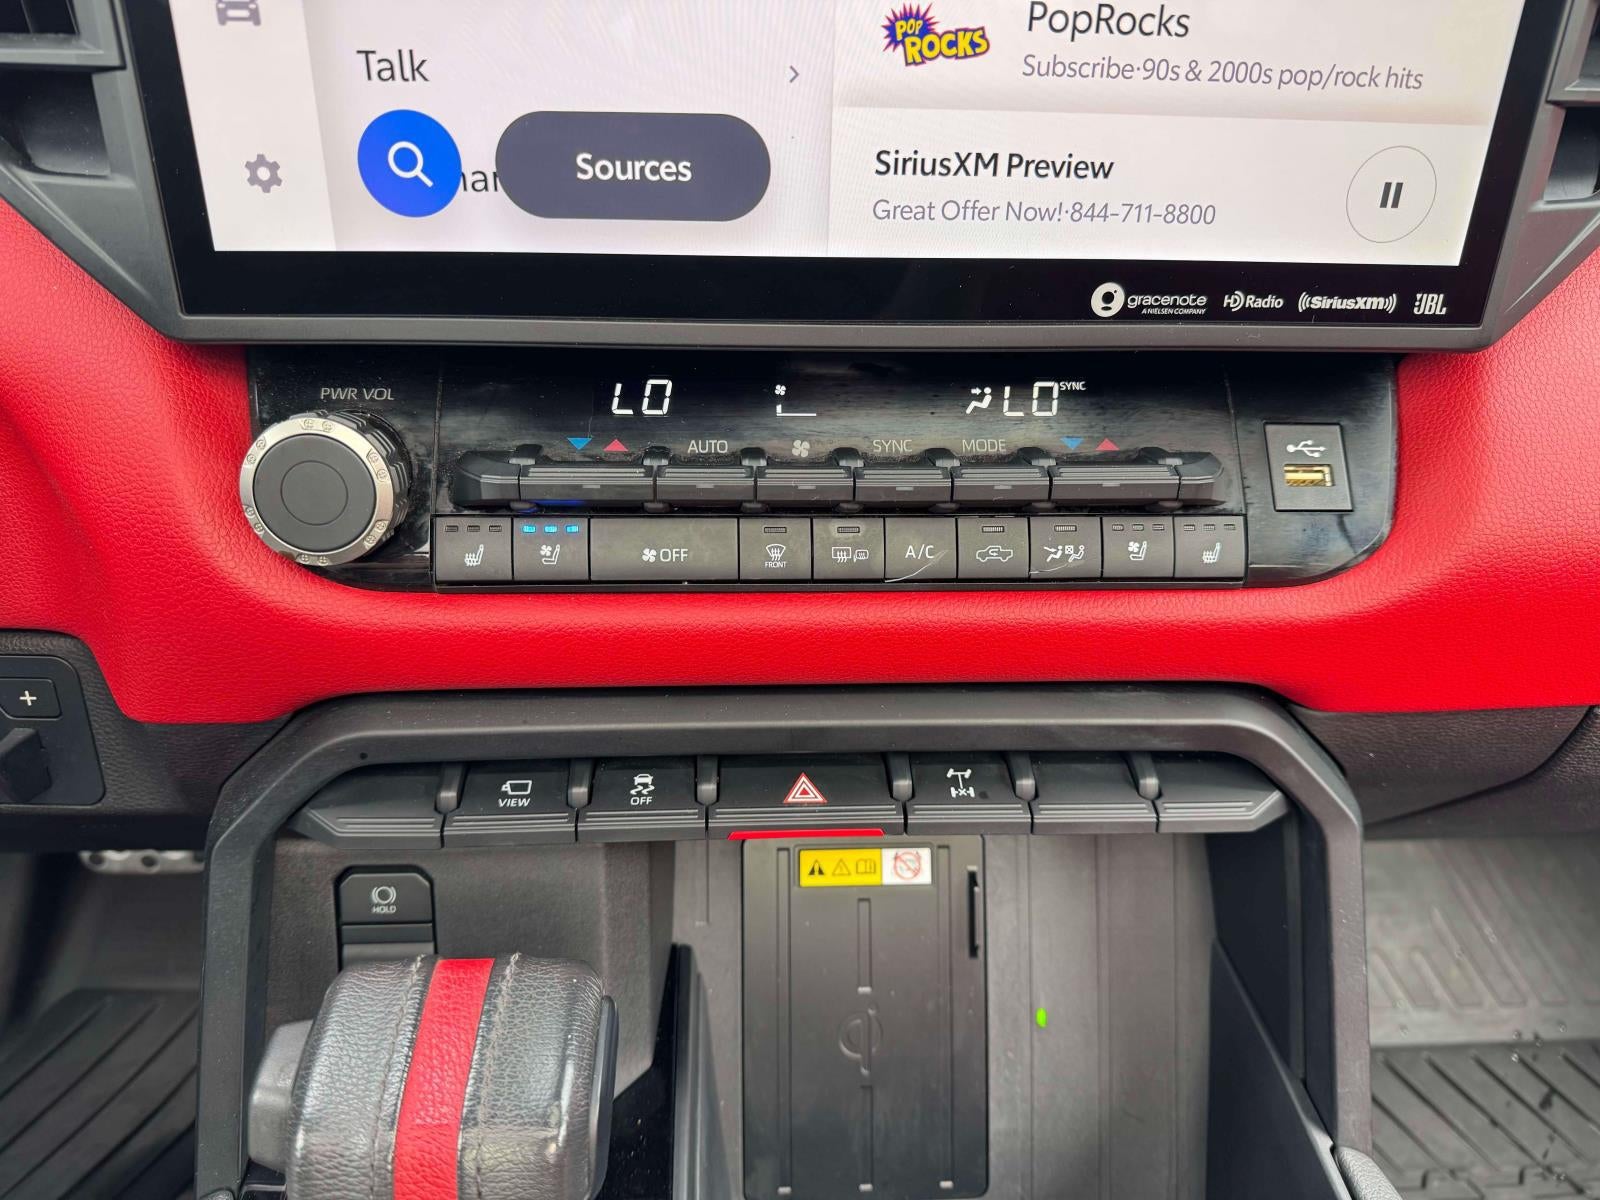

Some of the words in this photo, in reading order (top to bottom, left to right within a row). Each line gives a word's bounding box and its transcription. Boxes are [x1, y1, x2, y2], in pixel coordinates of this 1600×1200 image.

[1027, 1, 1191, 41] PopRocks
[895, 19, 924, 41] POP
[904, 29, 988, 64] ROCKS
[356, 49, 430, 82] Talk
[1185, 60, 1203, 82] &
[1208, 60, 1274, 86] 2000s
[1277, 64, 1382, 91] pop/rock
[1384, 66, 1424, 90] hits
[575, 152, 693, 183] Sources
[874, 150, 999, 178] SiriusXM
[1006, 153, 1115, 180] Preview
[872, 200, 936, 222] Great
[941, 200, 1001, 222] Offer
[1127, 293, 1207, 308] gracenote
[1245, 294, 1284, 309] Radio
[1414, 293, 1446, 315] JBL
[320, 387, 358, 402] PWR
[362, 387, 395, 402] VOL
[1059, 381, 1086, 392] SYNC
[687, 439, 729, 455] AUTO
[872, 439, 914, 455] SYNC
[961, 438, 1007, 454] MODE
[658, 547, 689, 564] OFF
[904, 544, 936, 562] A/C
[764, 561, 788, 569] FRONT
[498, 797, 531, 808] VIEW
[630, 796, 653, 806] OFF
[372, 905, 397, 914] HOLD
